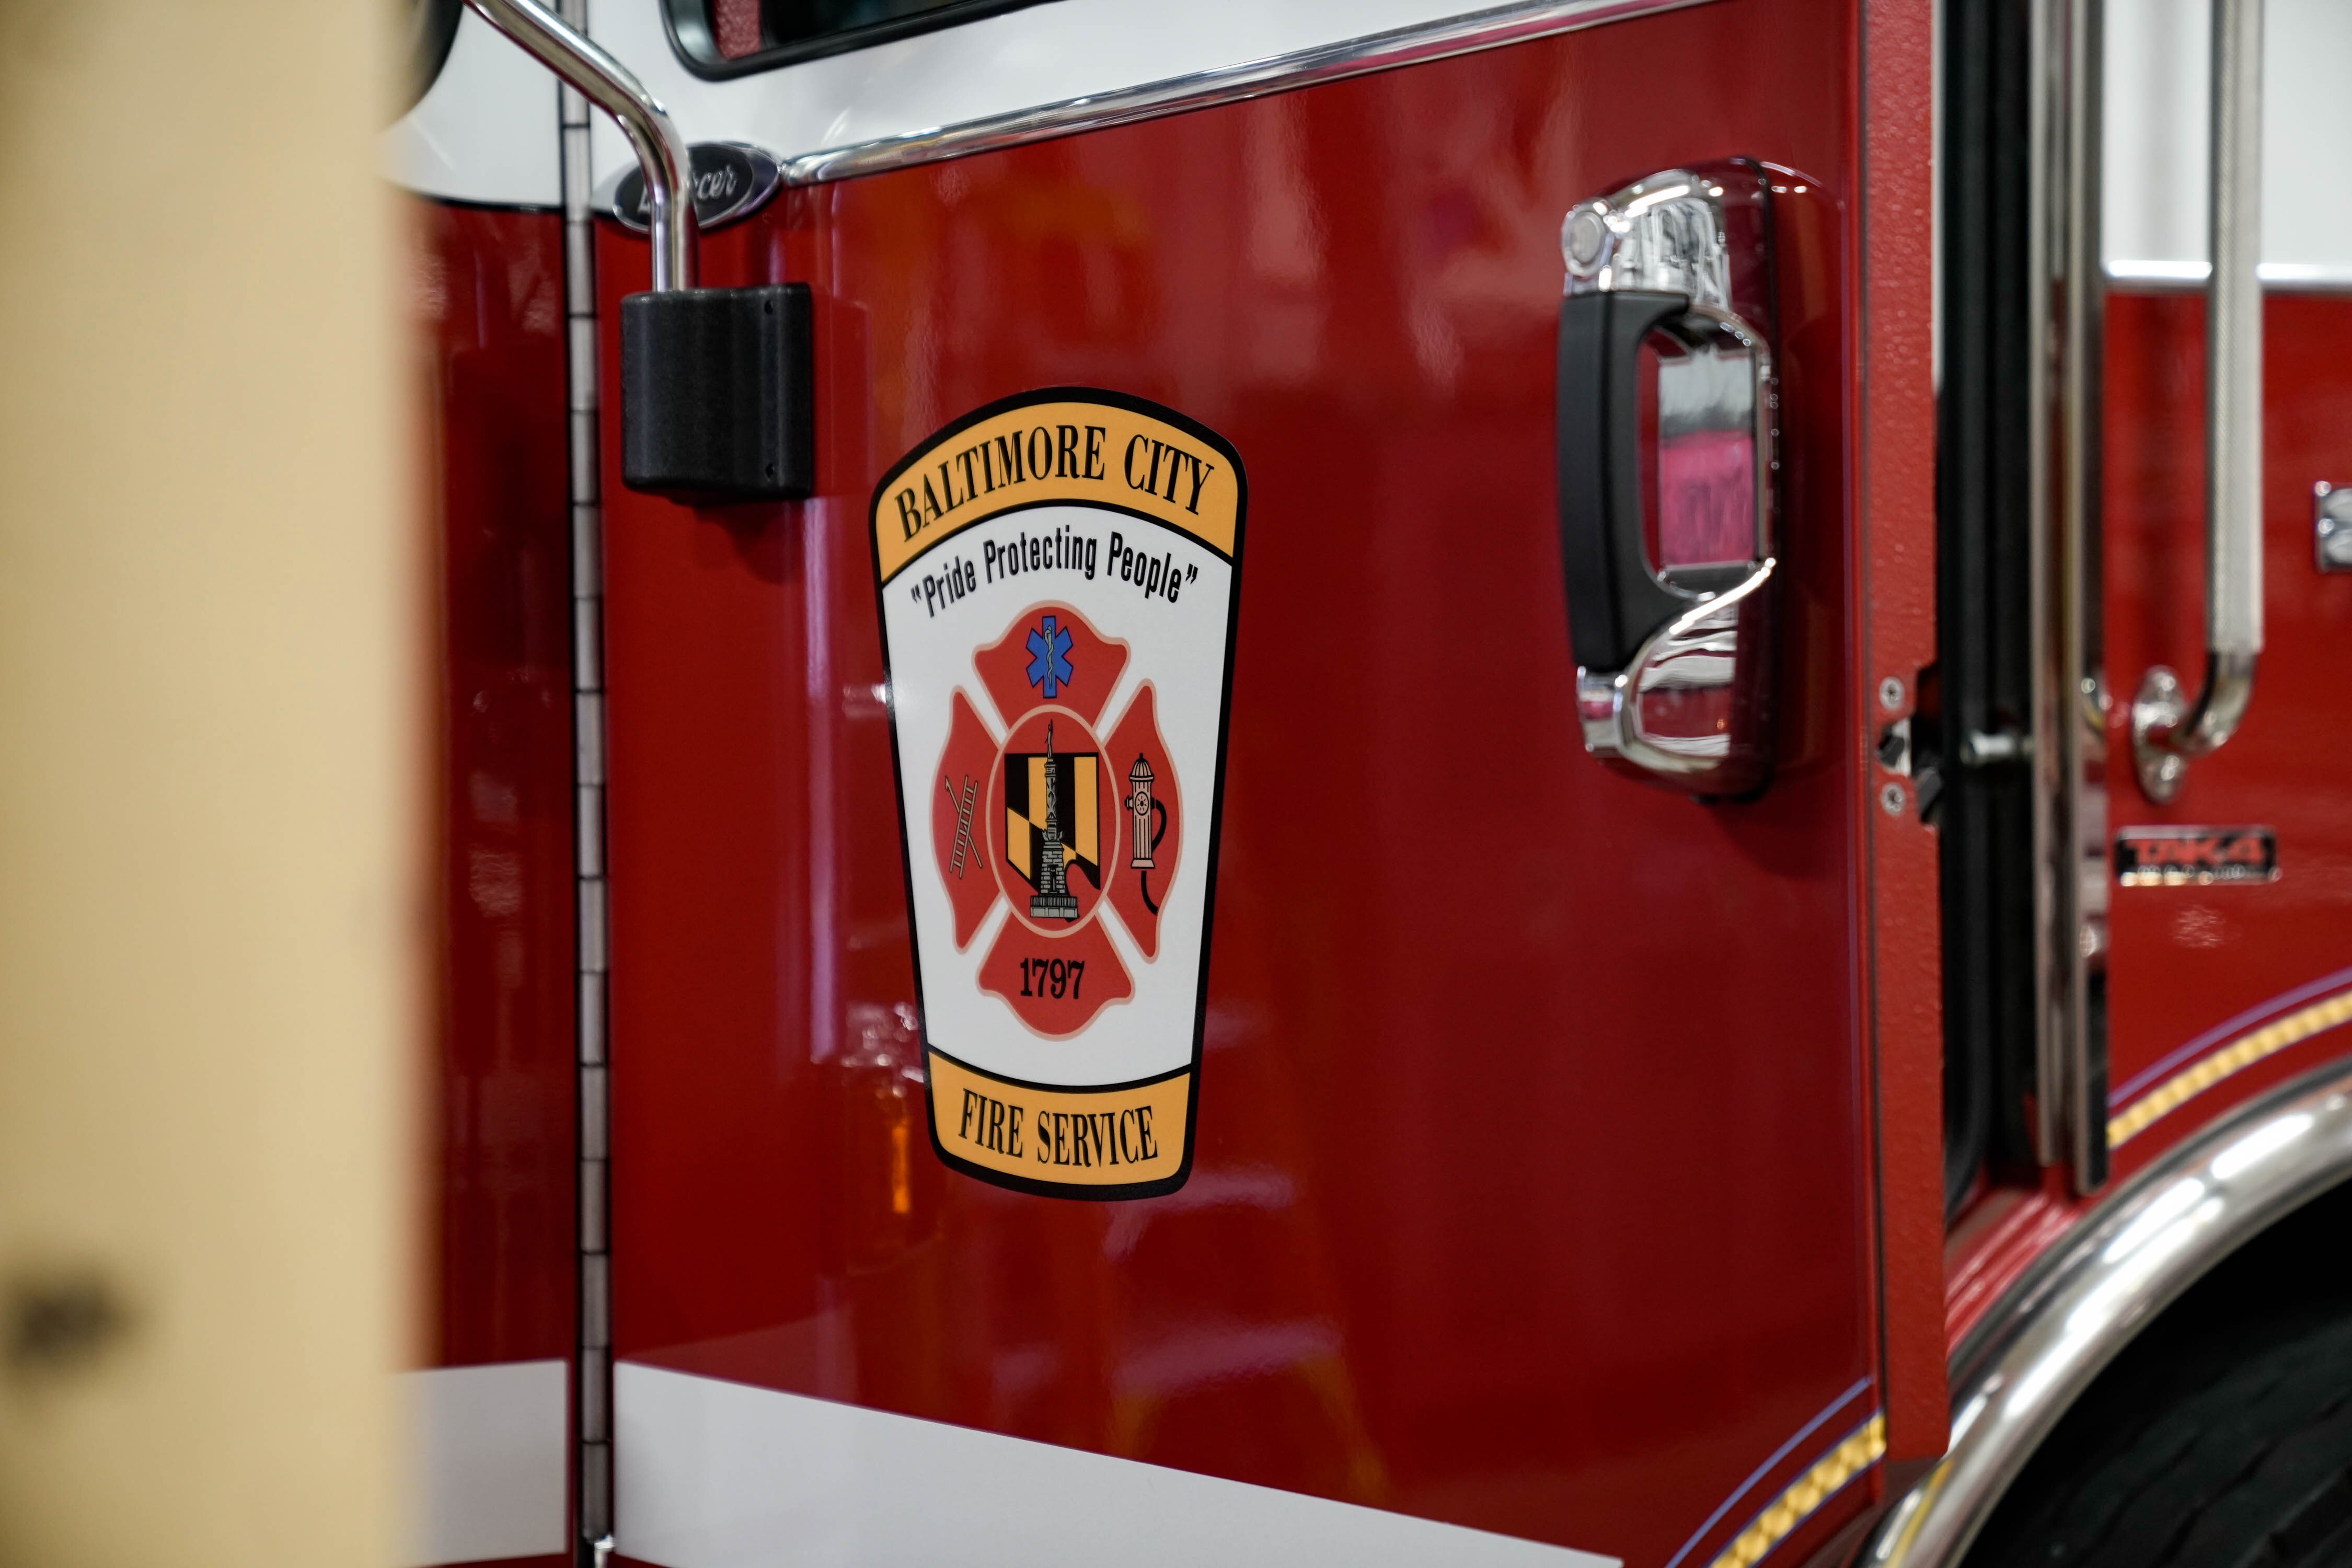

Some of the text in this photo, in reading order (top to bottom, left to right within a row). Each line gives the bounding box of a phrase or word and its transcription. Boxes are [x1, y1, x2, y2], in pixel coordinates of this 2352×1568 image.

[636, 163, 737, 214] cer
[894, 424, 1215, 543] BALTIMORE CITY
[983, 525, 1097, 584] Protecting
[1020, 958, 1086, 1000] 1797
[958, 1088, 1158, 1167] FIRE SERVICE
